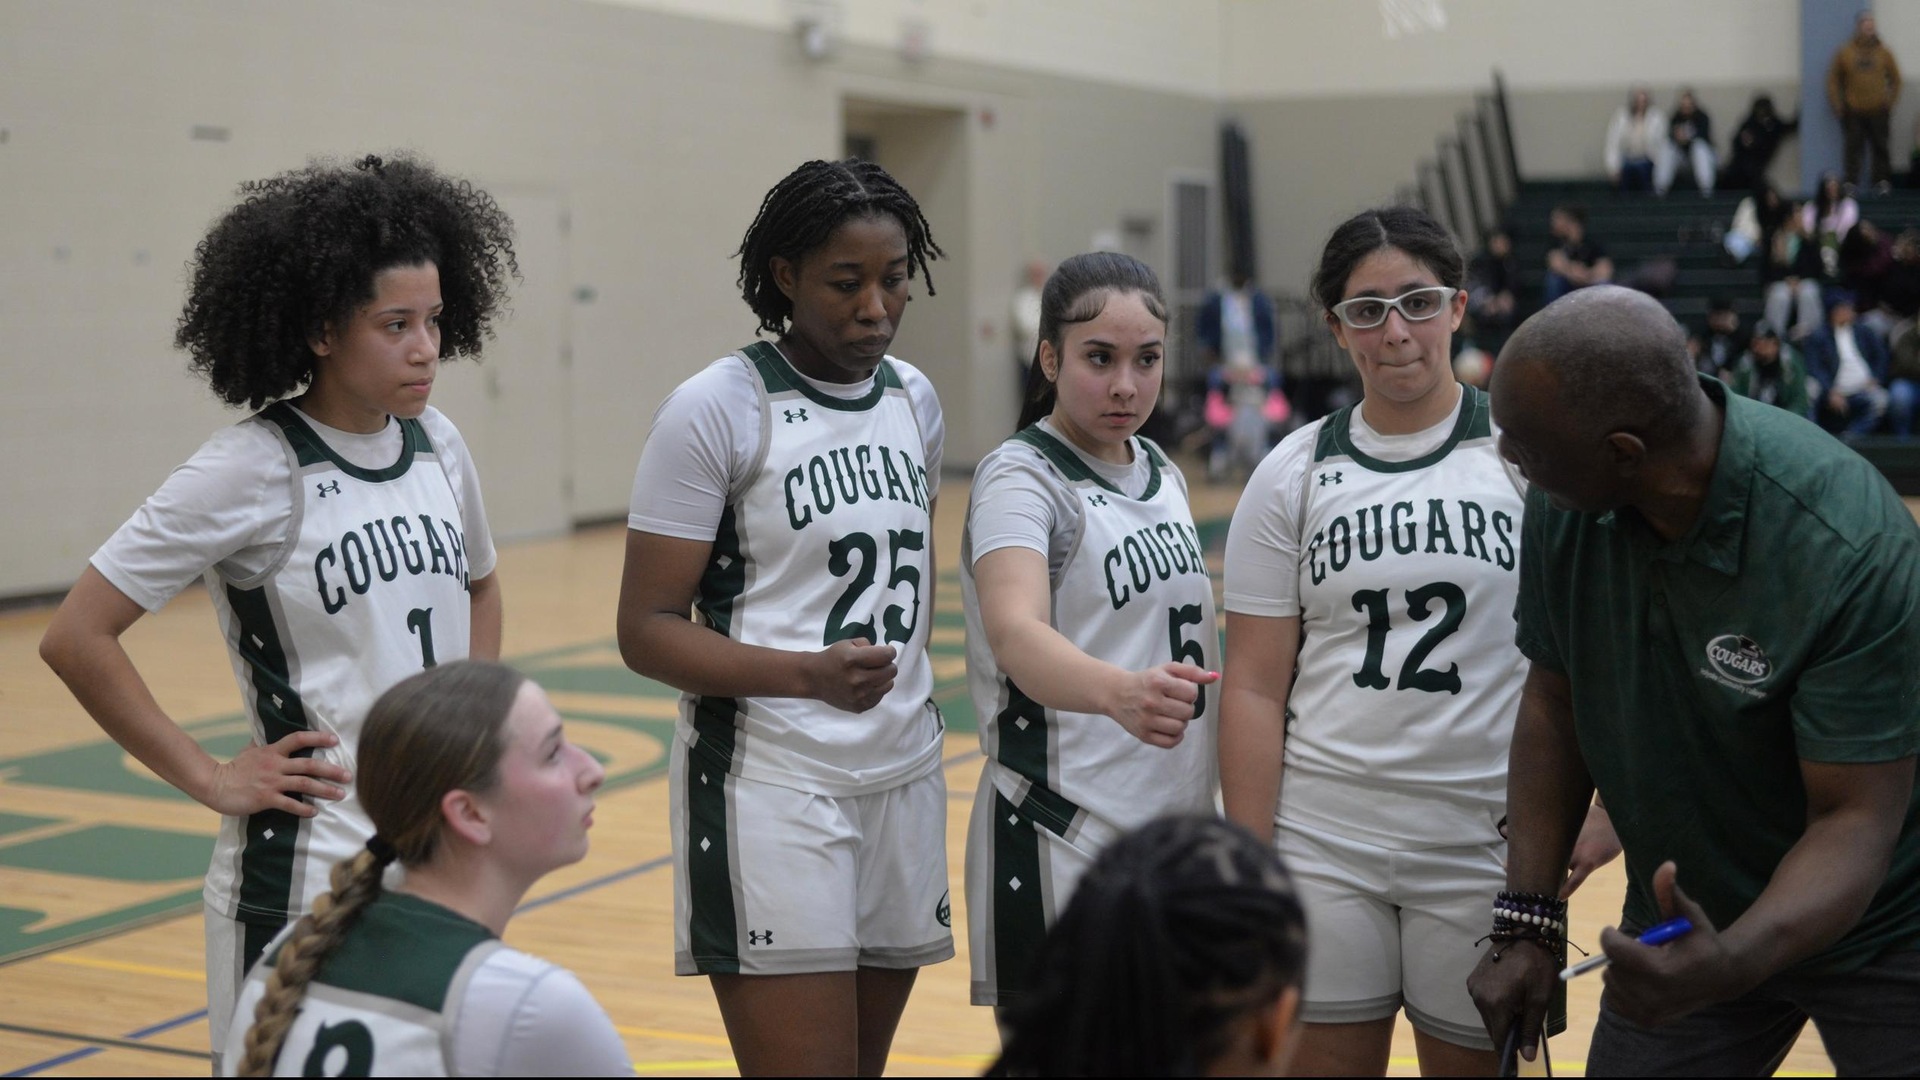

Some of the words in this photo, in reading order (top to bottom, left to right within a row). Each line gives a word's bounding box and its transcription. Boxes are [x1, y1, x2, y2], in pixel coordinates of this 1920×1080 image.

[823, 528, 924, 647] 25
[1308, 498, 1515, 586] COUGARS
[407, 607, 437, 671] 1
[1169, 603, 1206, 720] 5
[1351, 581, 1467, 695] 12
[1709, 645, 1767, 677] COUGARS
